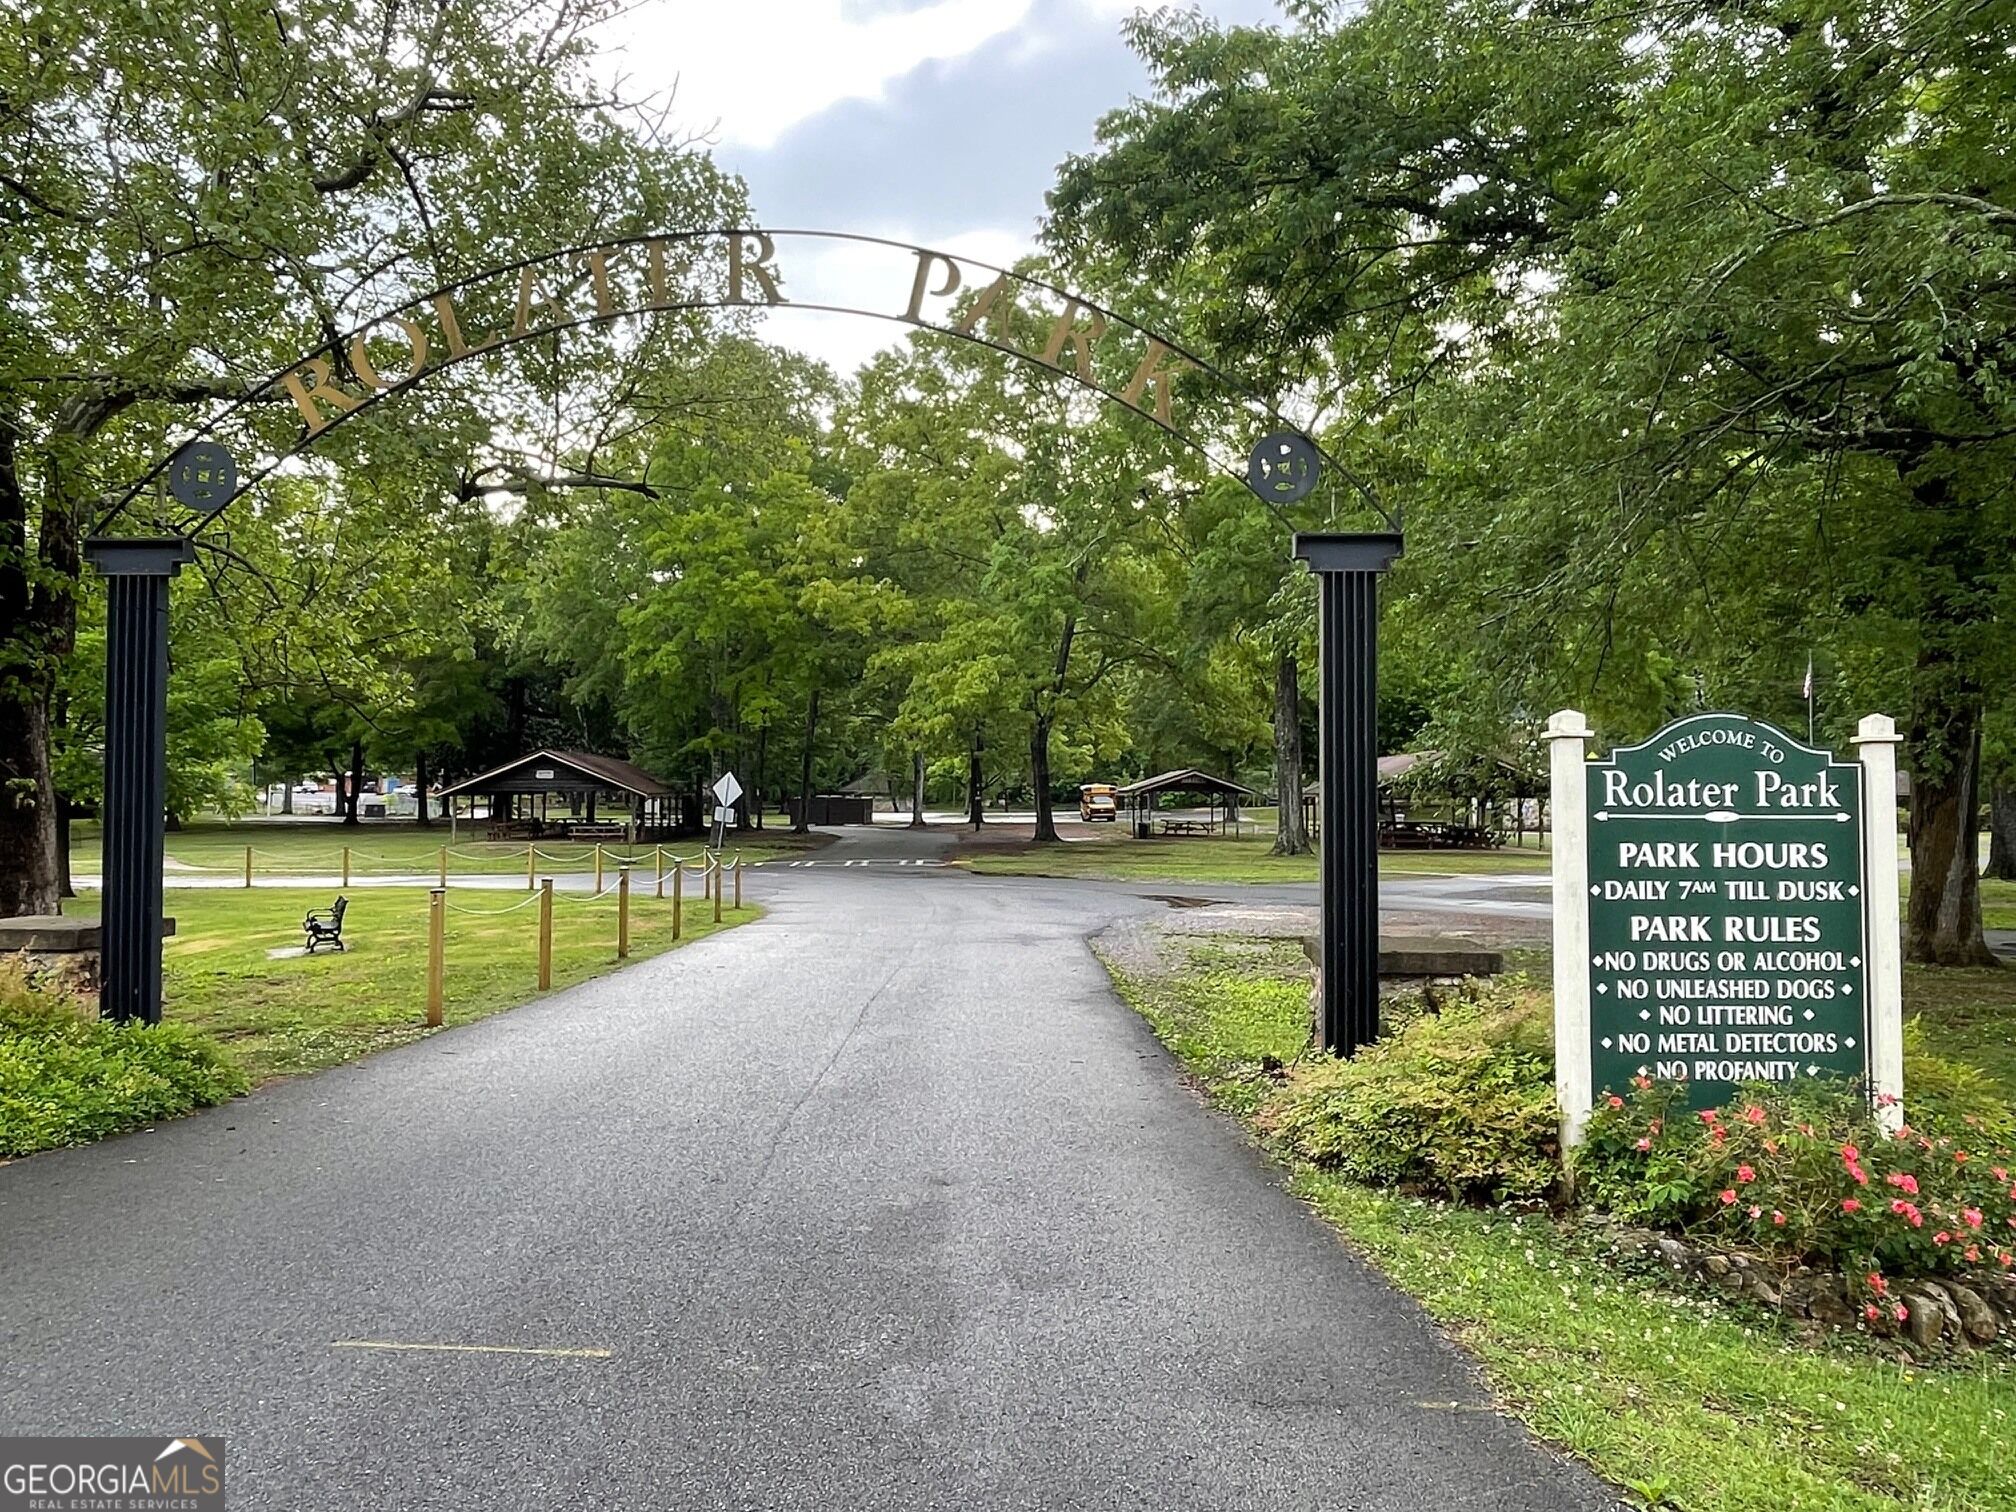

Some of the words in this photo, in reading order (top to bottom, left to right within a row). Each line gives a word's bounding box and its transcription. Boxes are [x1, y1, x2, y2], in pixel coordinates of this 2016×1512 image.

[280, 231, 787, 435] ROLATER
[898, 250, 1208, 428] PARK
[1658, 729, 1756, 763] WELCOME
[1761, 740, 1785, 765] TO
[1602, 769, 1739, 808] Rolater
[1754, 769, 1841, 808] Park
[1618, 842, 1700, 868] PARK
[1713, 842, 1829, 869] HOURS
[1604, 880, 1670, 900] DAILY
[1679, 880, 1717, 900] 7AM
[1725, 881, 1770, 900] TILL
[1778, 881, 1845, 901] DUSK
[1630, 916, 1712, 941] PARK
[1725, 916, 1821, 942] RULES
[1604, 952, 1636, 972] NO
[1643, 952, 1710, 972] DRUGS
[1717, 952, 1746, 972] OR
[1753, 952, 1846, 972] ALCOHOL
[1617, 979, 1648, 999] NO
[1656, 979, 1770, 999] UNLEASHED
[1777, 979, 1836, 999] DOGS
[1659, 1005, 1690, 1025] NO
[1697, 1005, 1793, 1025] LITTERING
[1618, 1033, 1650, 1053] NO
[1658, 1033, 1719, 1052] METAL
[1725, 1033, 1838, 1053] DETECTORS
[1656, 1060, 1688, 1080] NO
[1694, 1060, 1800, 1080] PROFANITY
